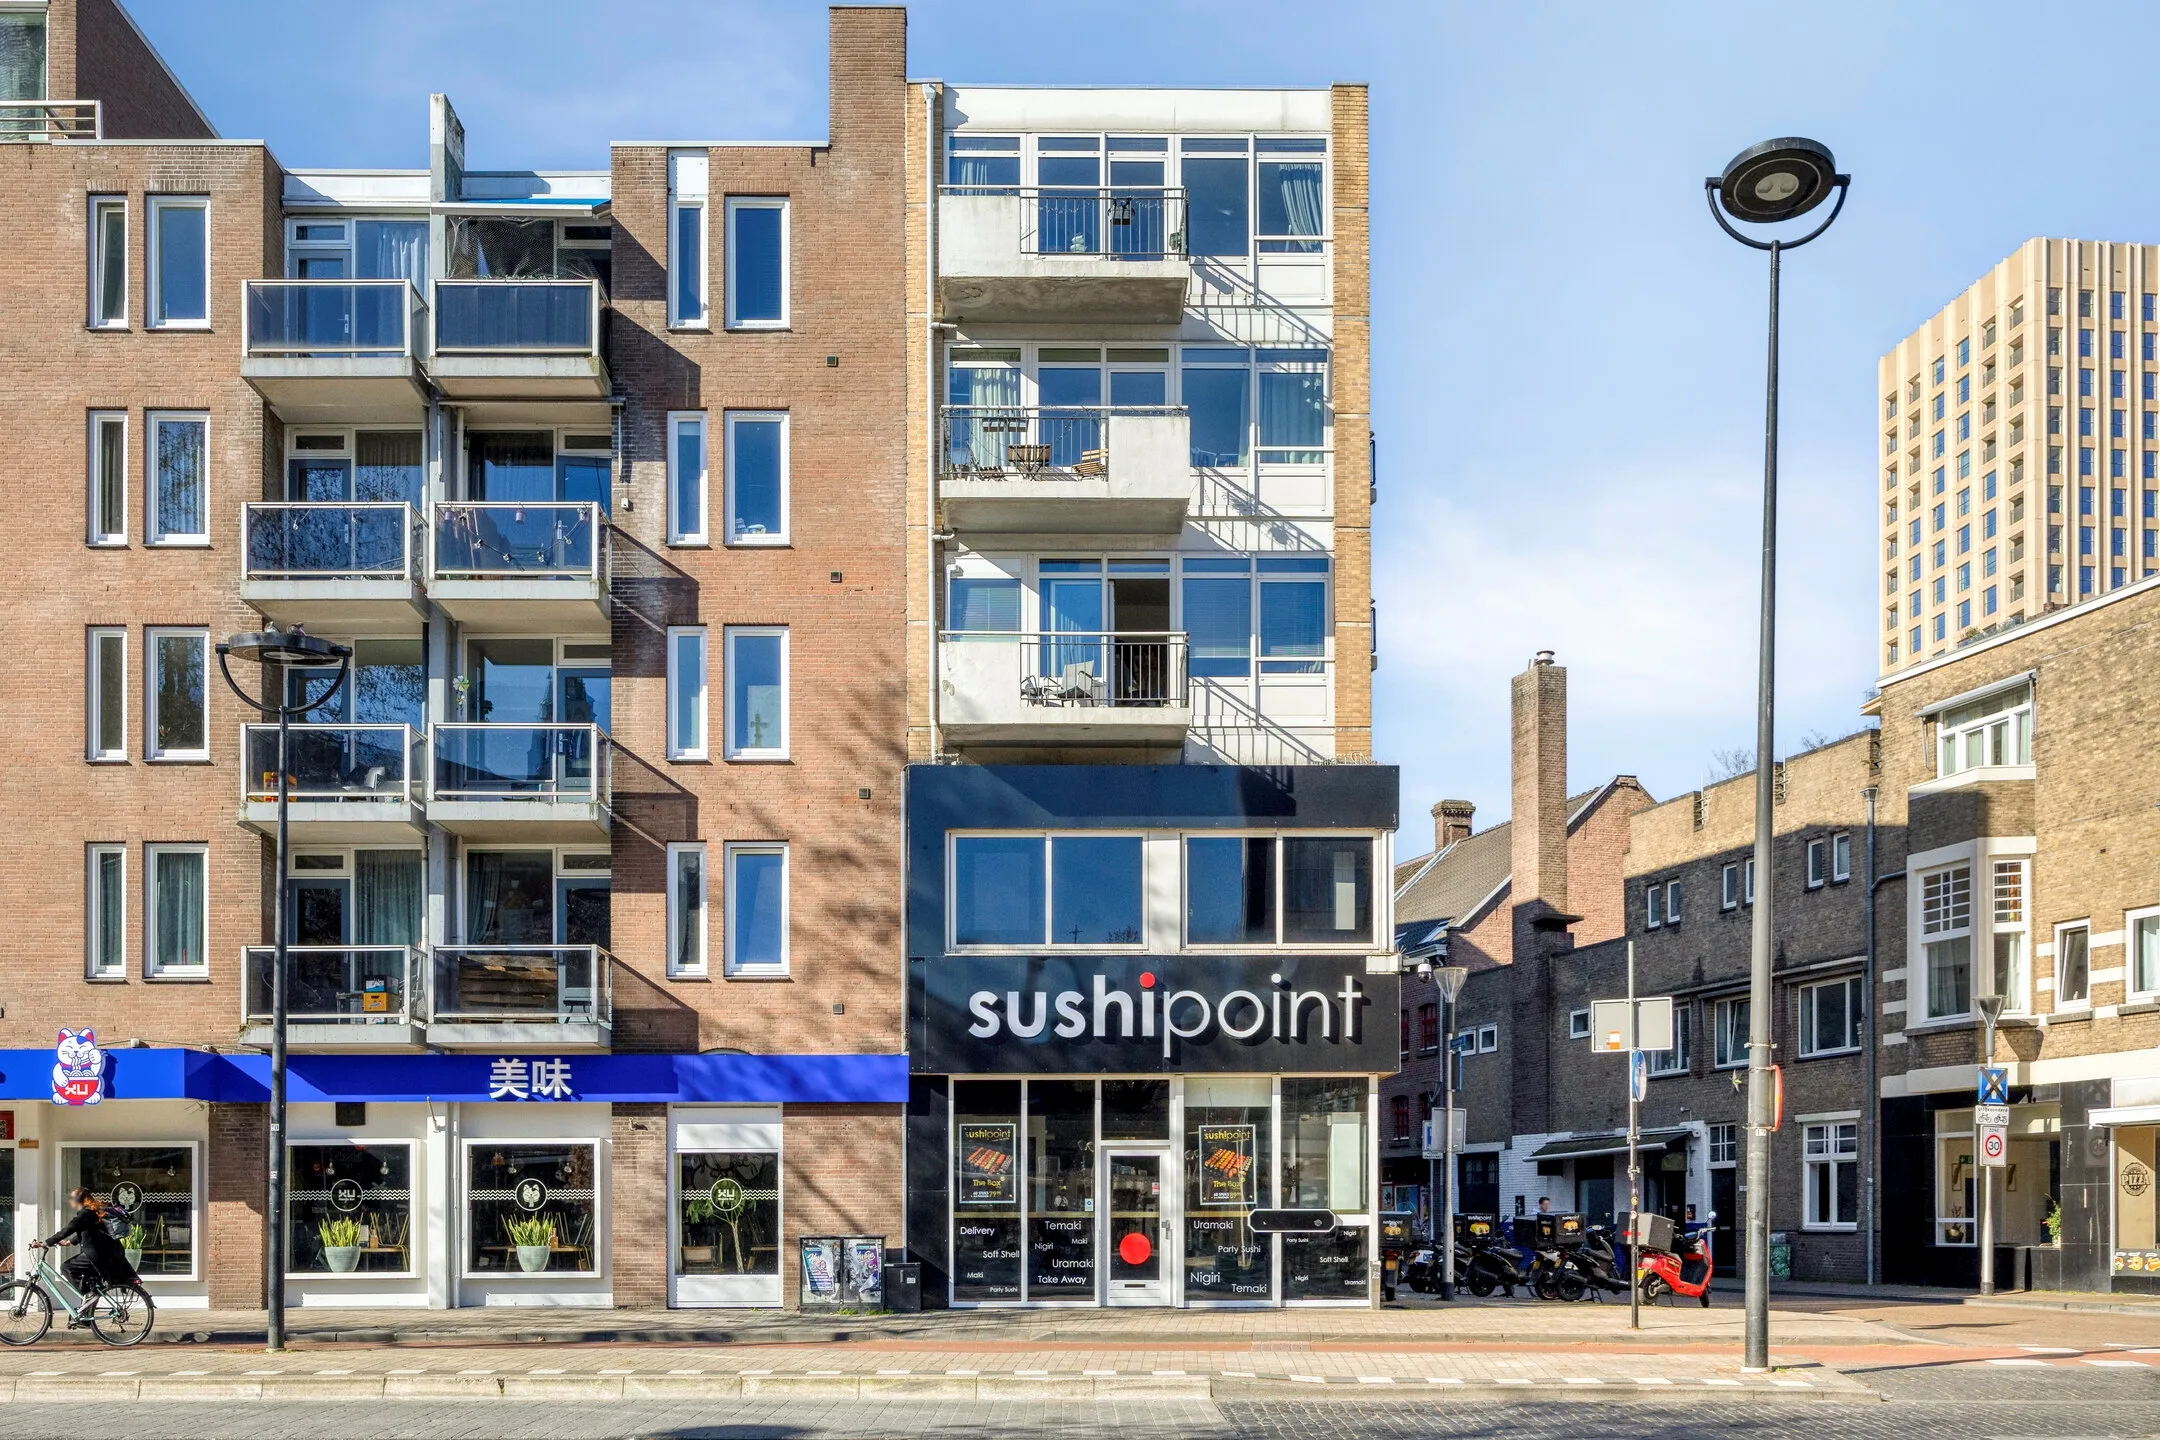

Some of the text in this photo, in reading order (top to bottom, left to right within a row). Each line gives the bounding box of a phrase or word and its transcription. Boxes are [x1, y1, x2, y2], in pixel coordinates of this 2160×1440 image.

[968, 972, 1362, 1058] sushipoint
[489, 1057, 573, 1099] 美味
[65, 1083, 89, 1096] XU
[966, 1129, 1011, 1139] sushipoint
[1204, 1130, 1251, 1142] sushipoint
[1988, 1141, 2000, 1151] 30
[973, 1179, 1001, 1187] The Box
[1213, 1180, 1241, 1188] The Box
[2120, 1174, 2150, 1187] PIZZA
[338, 1189, 356, 1198] XU
[717, 1189, 735, 1198] XU
[1045, 1220, 1082, 1230] Temaki
[1193, 1220, 1234, 1230] Uramaki
[960, 1226, 995, 1236] Delivery
[1034, 1242, 1054, 1251] Nigiri
[1217, 1245, 1261, 1254] Party Sushi
[982, 1250, 1020, 1259] Soft Shell
[1052, 1258, 1094, 1268] Uramaki
[966, 1271, 984, 1279] Maki
[1037, 1275, 1087, 1285] Take Away
[1190, 1271, 1221, 1286] Nigiri
[1231, 1283, 1267, 1293] Temaki
